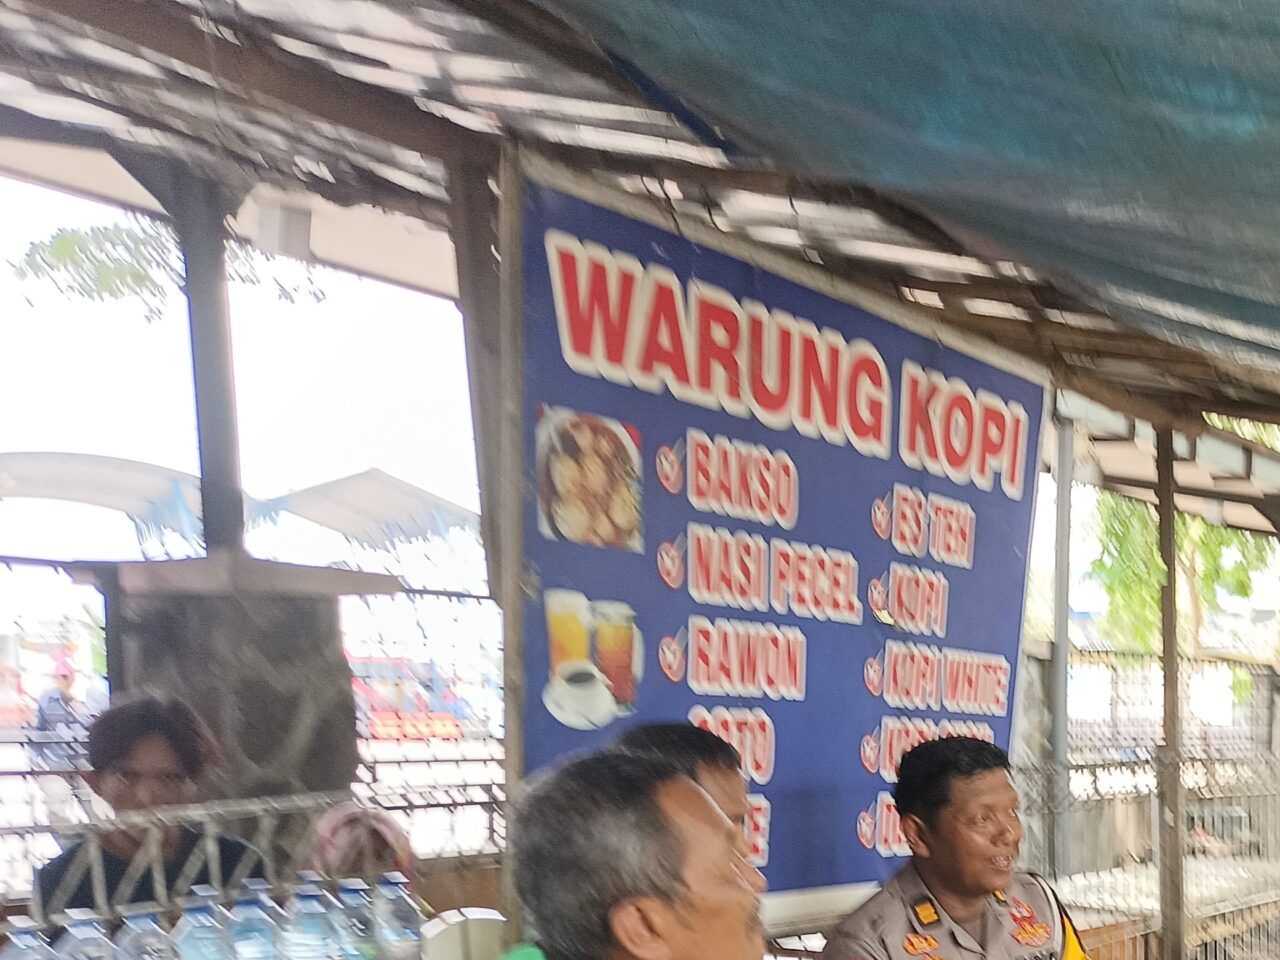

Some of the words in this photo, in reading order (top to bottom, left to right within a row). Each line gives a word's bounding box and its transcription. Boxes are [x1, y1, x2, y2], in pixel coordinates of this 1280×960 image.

[547, 230, 890, 459] WARUNG
[900, 361, 1029, 500] KOPI
[687, 428, 798, 529] BAKSO
[892, 483, 928, 558] ES
[928, 492, 976, 570] TEH
[687, 521, 769, 612] NASI
[770, 537, 863, 625] PECEL
[889, 561, 948, 638] KOPI
[687, 614, 806, 701] RAWON
[883, 639, 942, 711] KOPI
